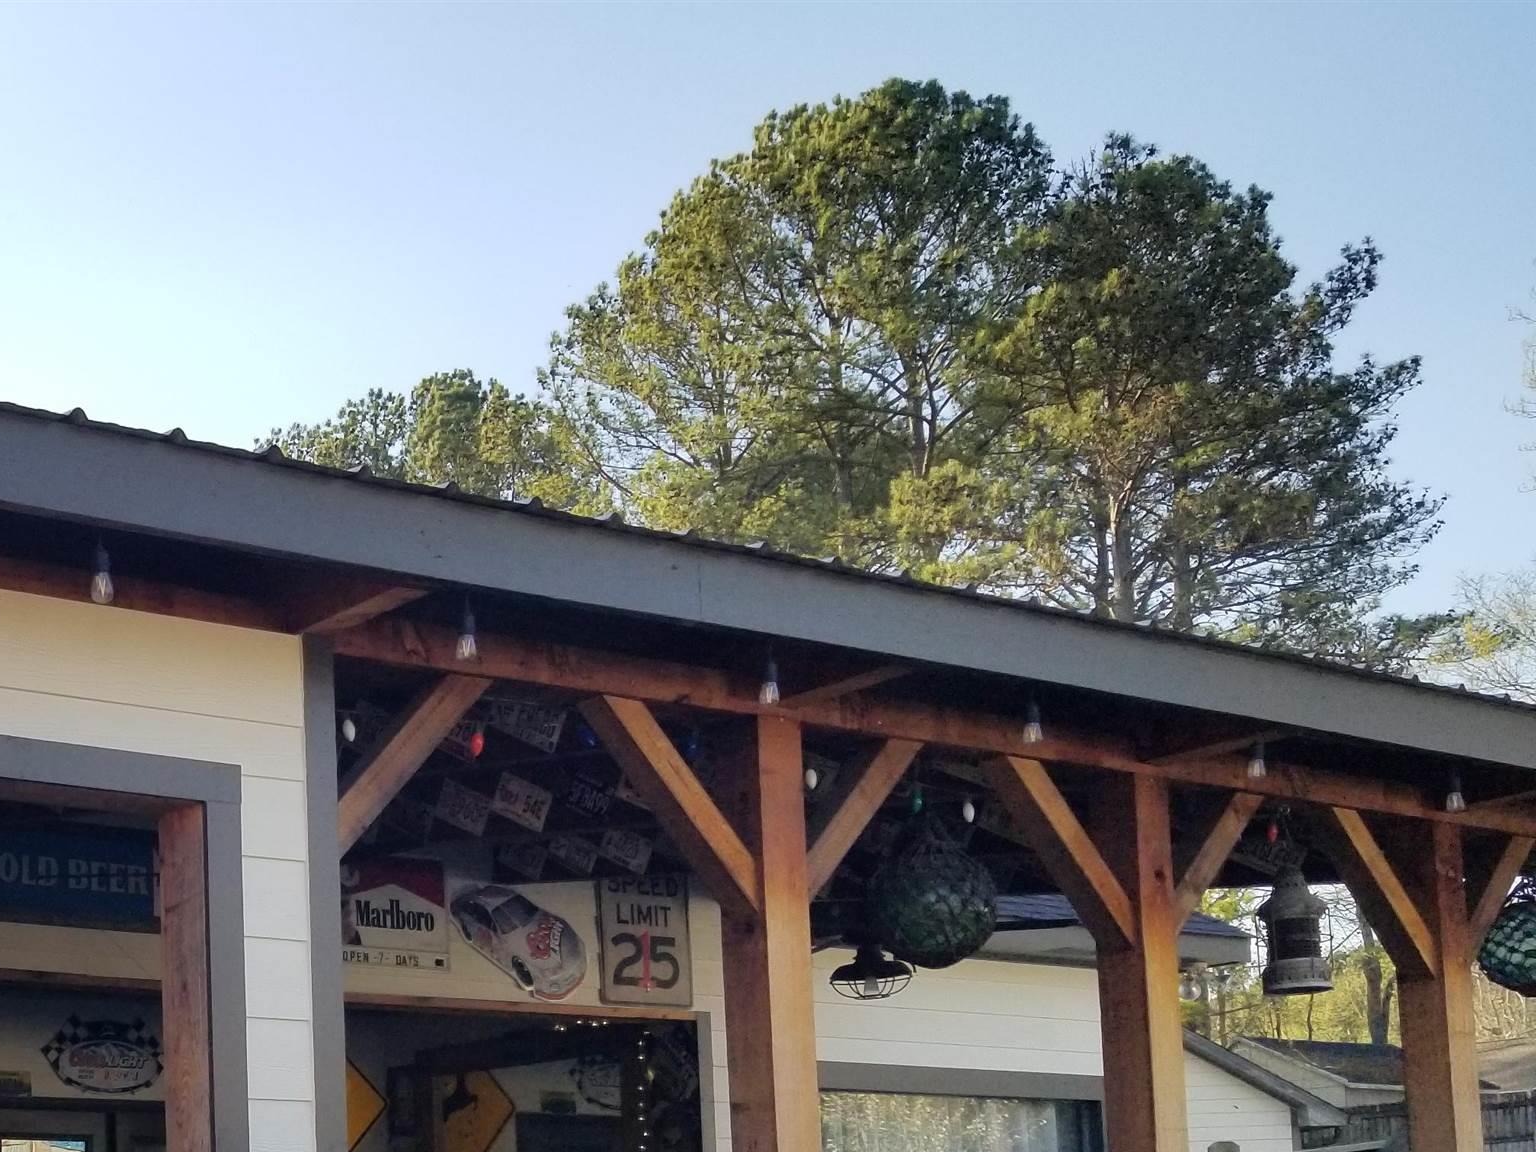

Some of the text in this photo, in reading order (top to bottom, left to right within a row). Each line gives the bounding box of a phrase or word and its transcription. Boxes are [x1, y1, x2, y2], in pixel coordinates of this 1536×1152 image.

[68, 858, 149, 896] BEER
[608, 878, 678, 896] SPEED
[354, 899, 435, 932] Marlboro
[617, 903, 671, 927] LIMIT
[342, 951, 369, 963] OPEN
[396, 954, 419, 967] DAYS
